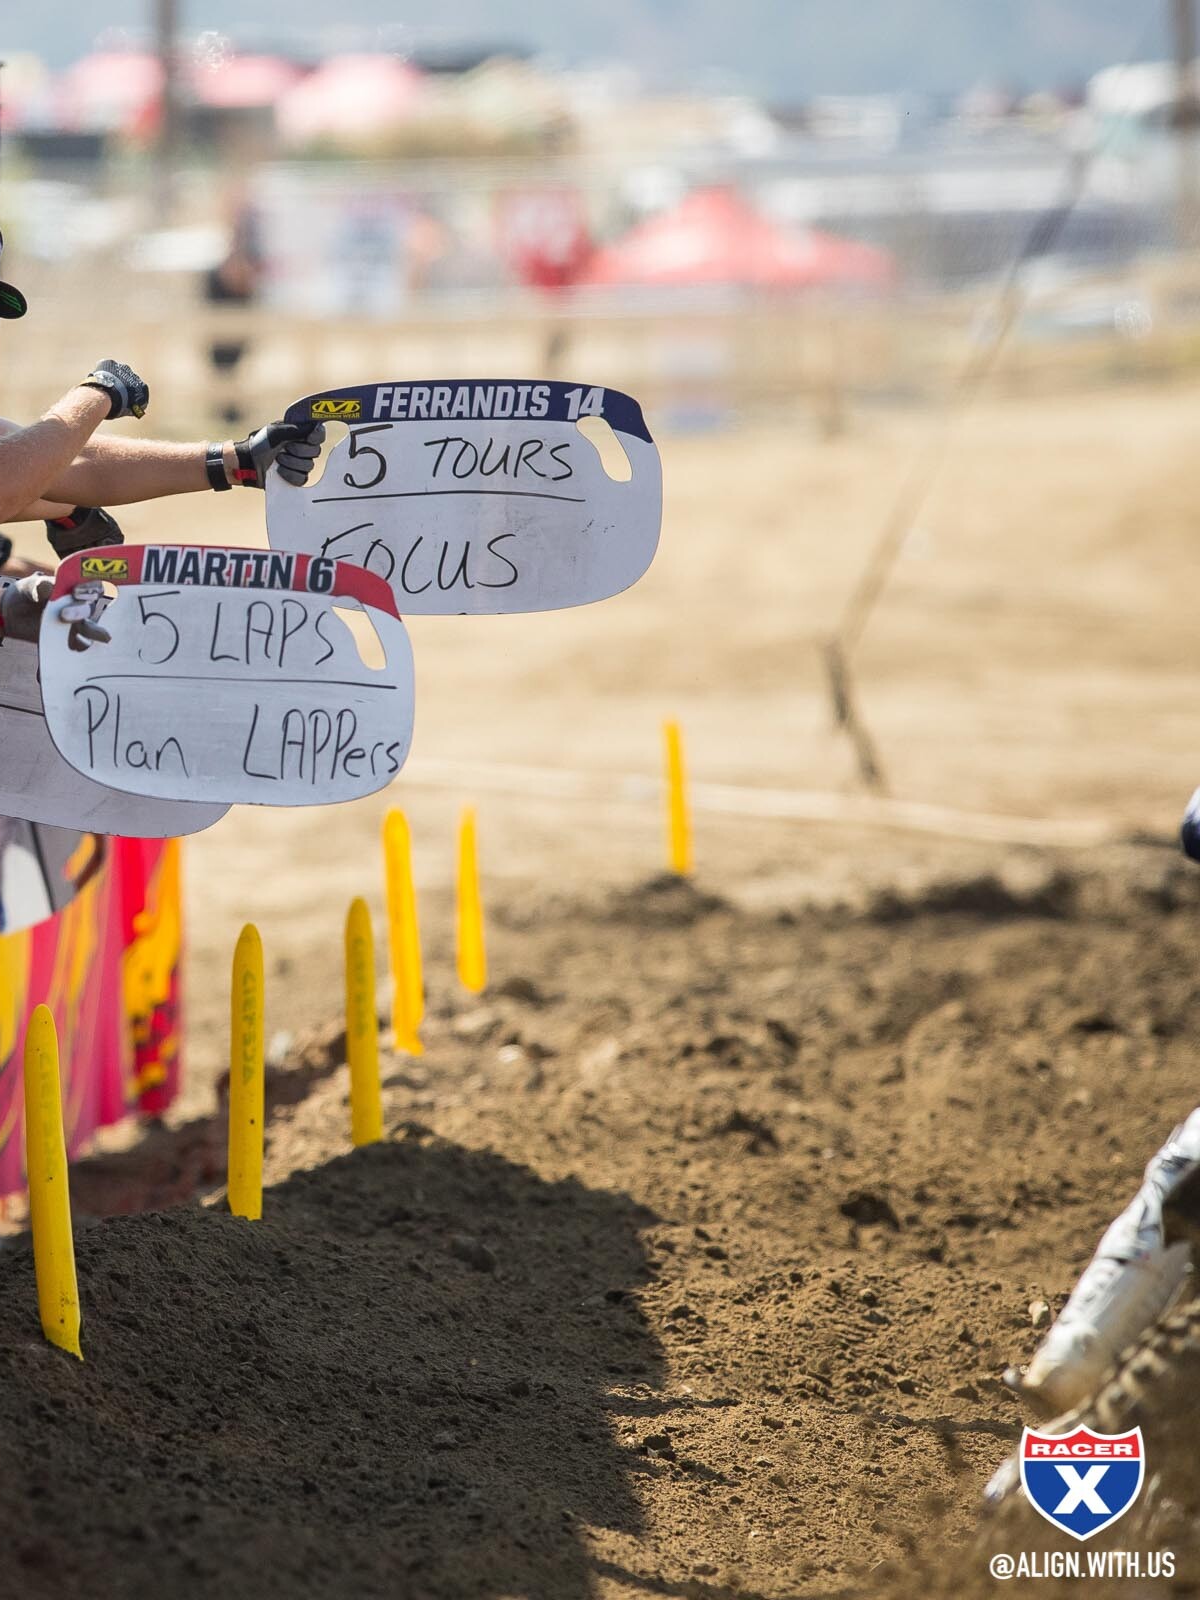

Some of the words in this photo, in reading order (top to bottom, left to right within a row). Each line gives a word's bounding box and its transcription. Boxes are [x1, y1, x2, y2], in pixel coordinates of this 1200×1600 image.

[373, 386, 550, 419] FERRANDIS
[564, 387, 605, 420] 14
[343, 423, 394, 489] 5
[424, 436, 573, 482] TOURS
[142, 545, 297, 592] MARTIN
[306, 556, 337, 595] 6
[137, 590, 181, 665] 5
[209, 599, 335, 668] LAPS
[73, 685, 190, 779] Plan
